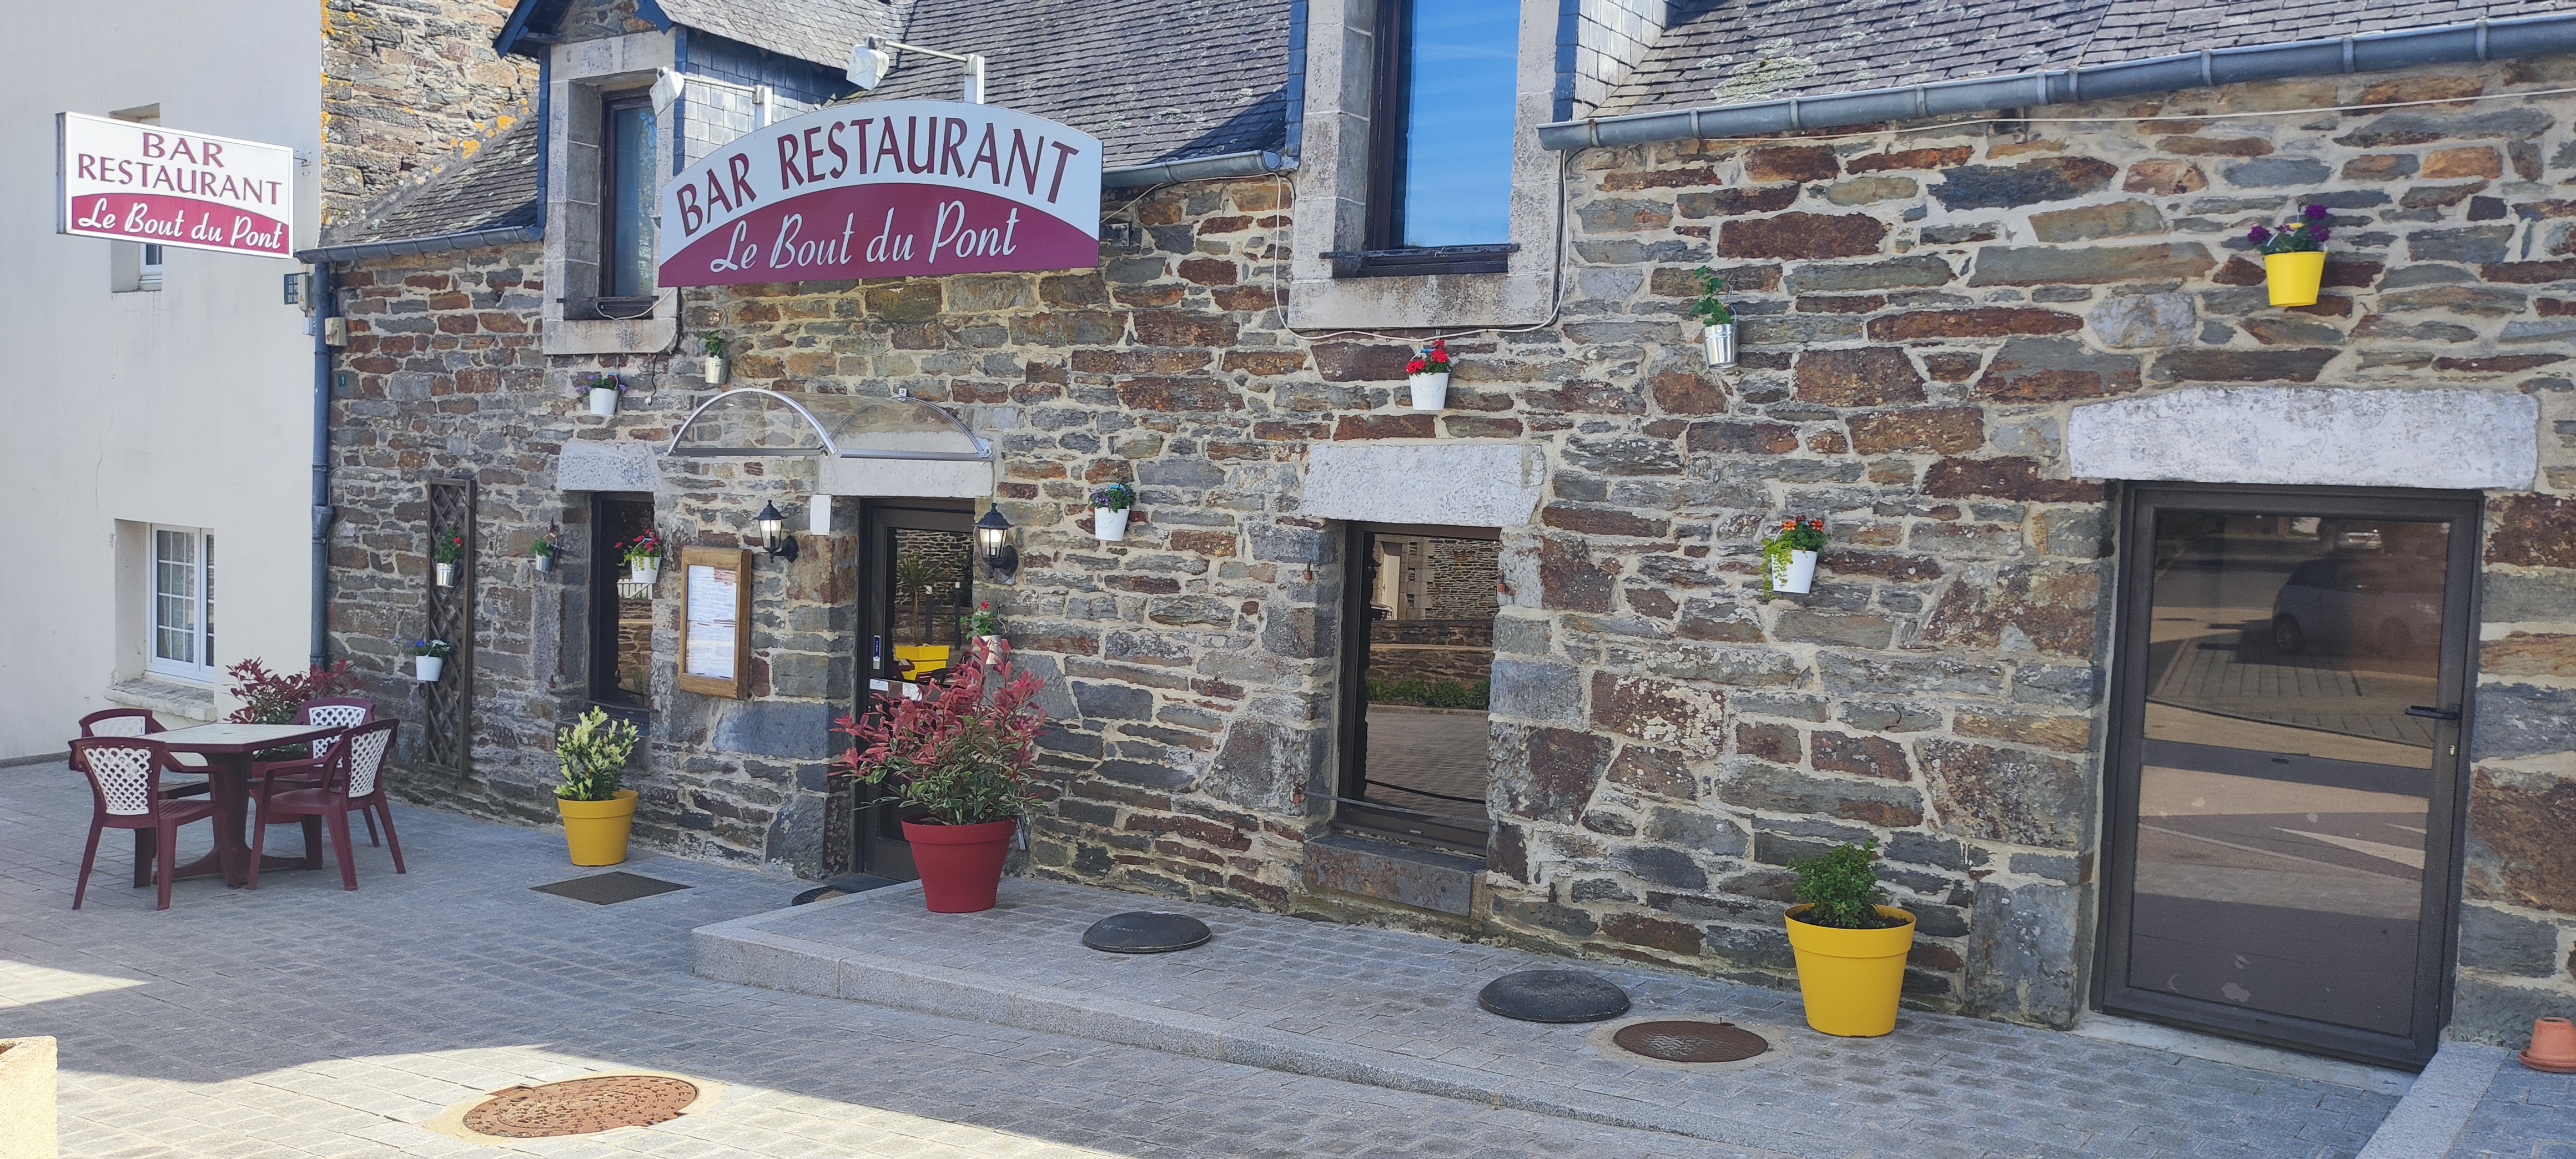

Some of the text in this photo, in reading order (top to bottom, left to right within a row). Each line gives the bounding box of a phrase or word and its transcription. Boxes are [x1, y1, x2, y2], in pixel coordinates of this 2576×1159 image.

[143, 132, 224, 168] BAR
[676, 115, 1079, 236] BAR RESTAURANT
[78, 153, 283, 205] RESTAURANT
[77, 197, 282, 249] Le Bout du Pont
[710, 200, 1021, 273] Le Bout du Pont
